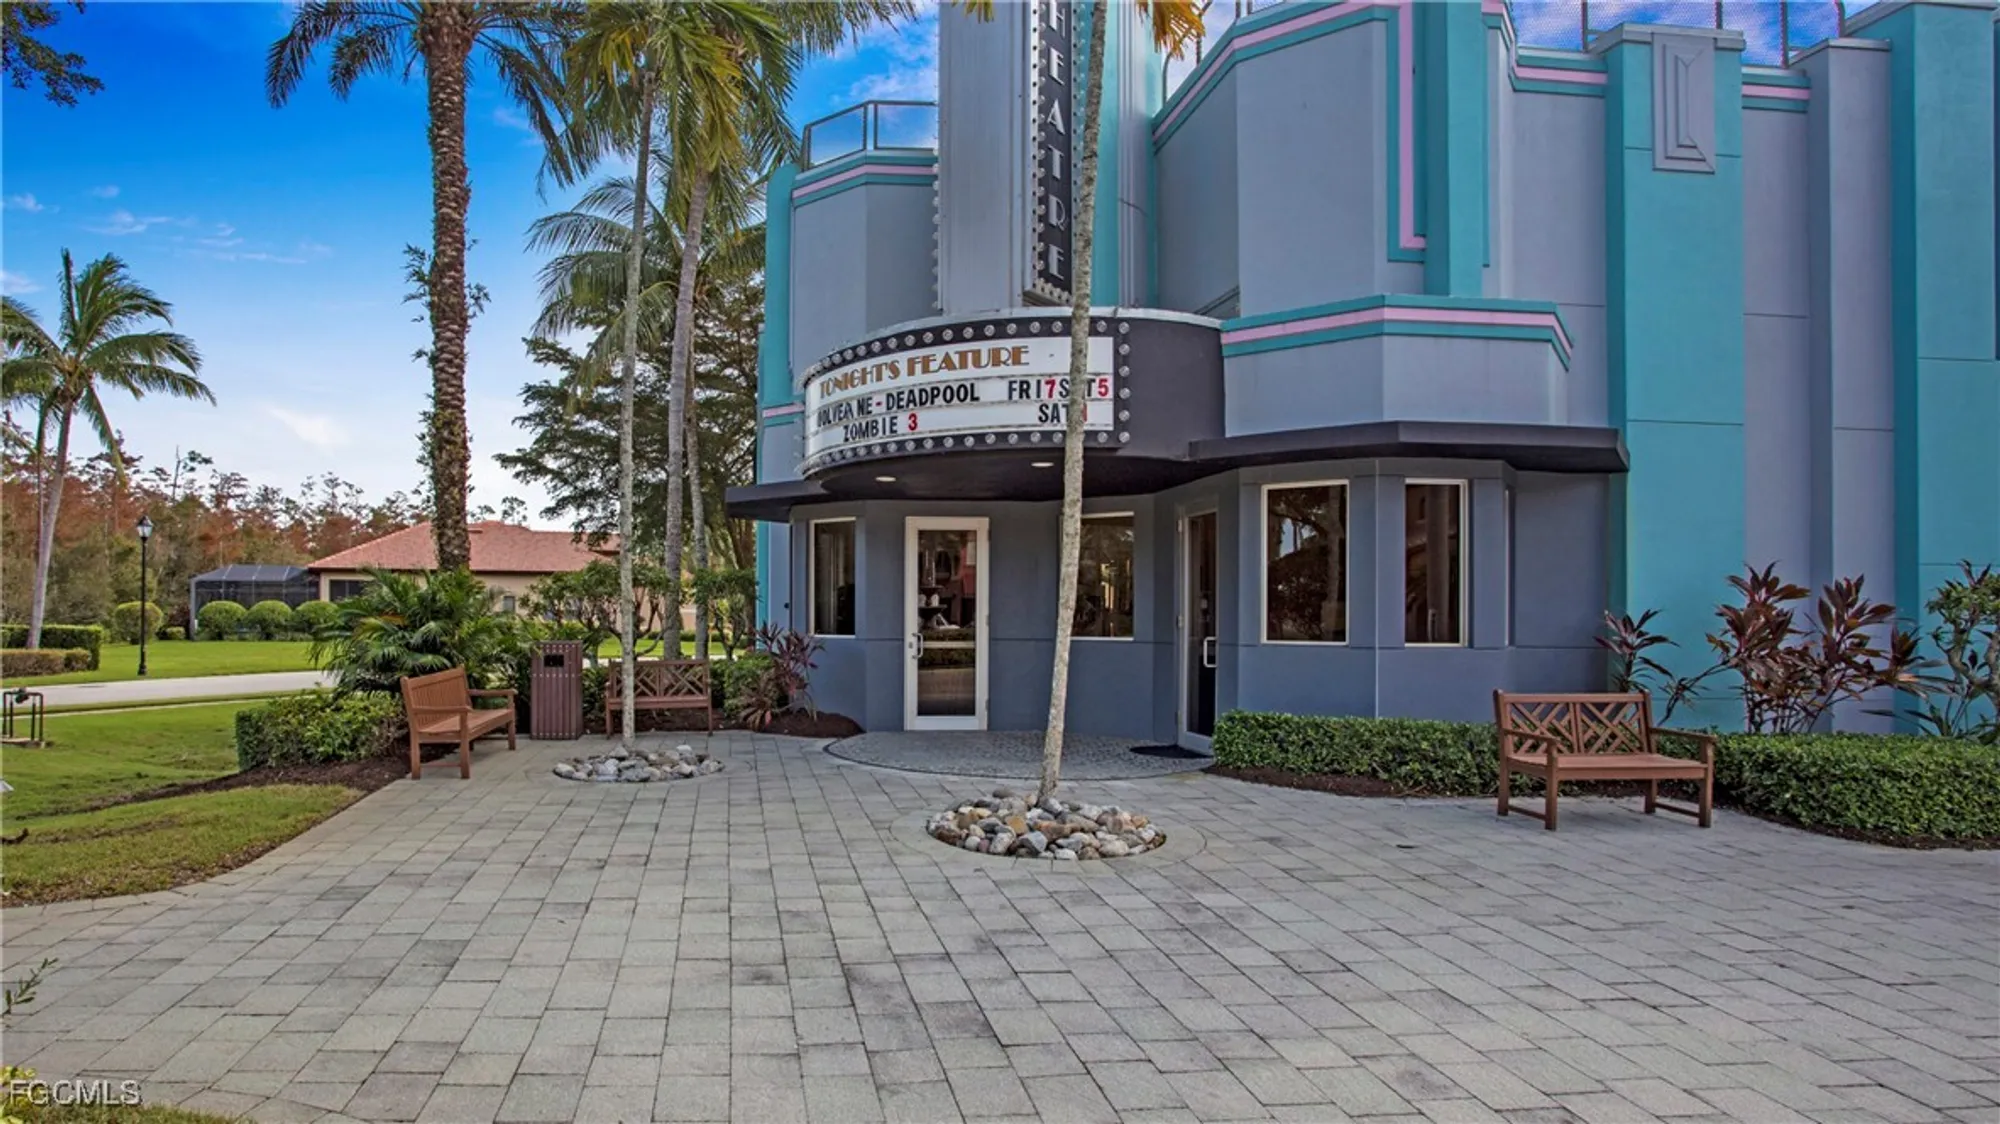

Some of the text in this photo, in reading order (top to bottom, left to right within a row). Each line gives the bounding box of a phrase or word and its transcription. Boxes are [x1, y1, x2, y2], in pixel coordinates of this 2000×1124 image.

[906, 345, 1030, 377] FEATURE
[842, 415, 898, 442] ZOMBIE
[908, 412, 918, 432] 3
